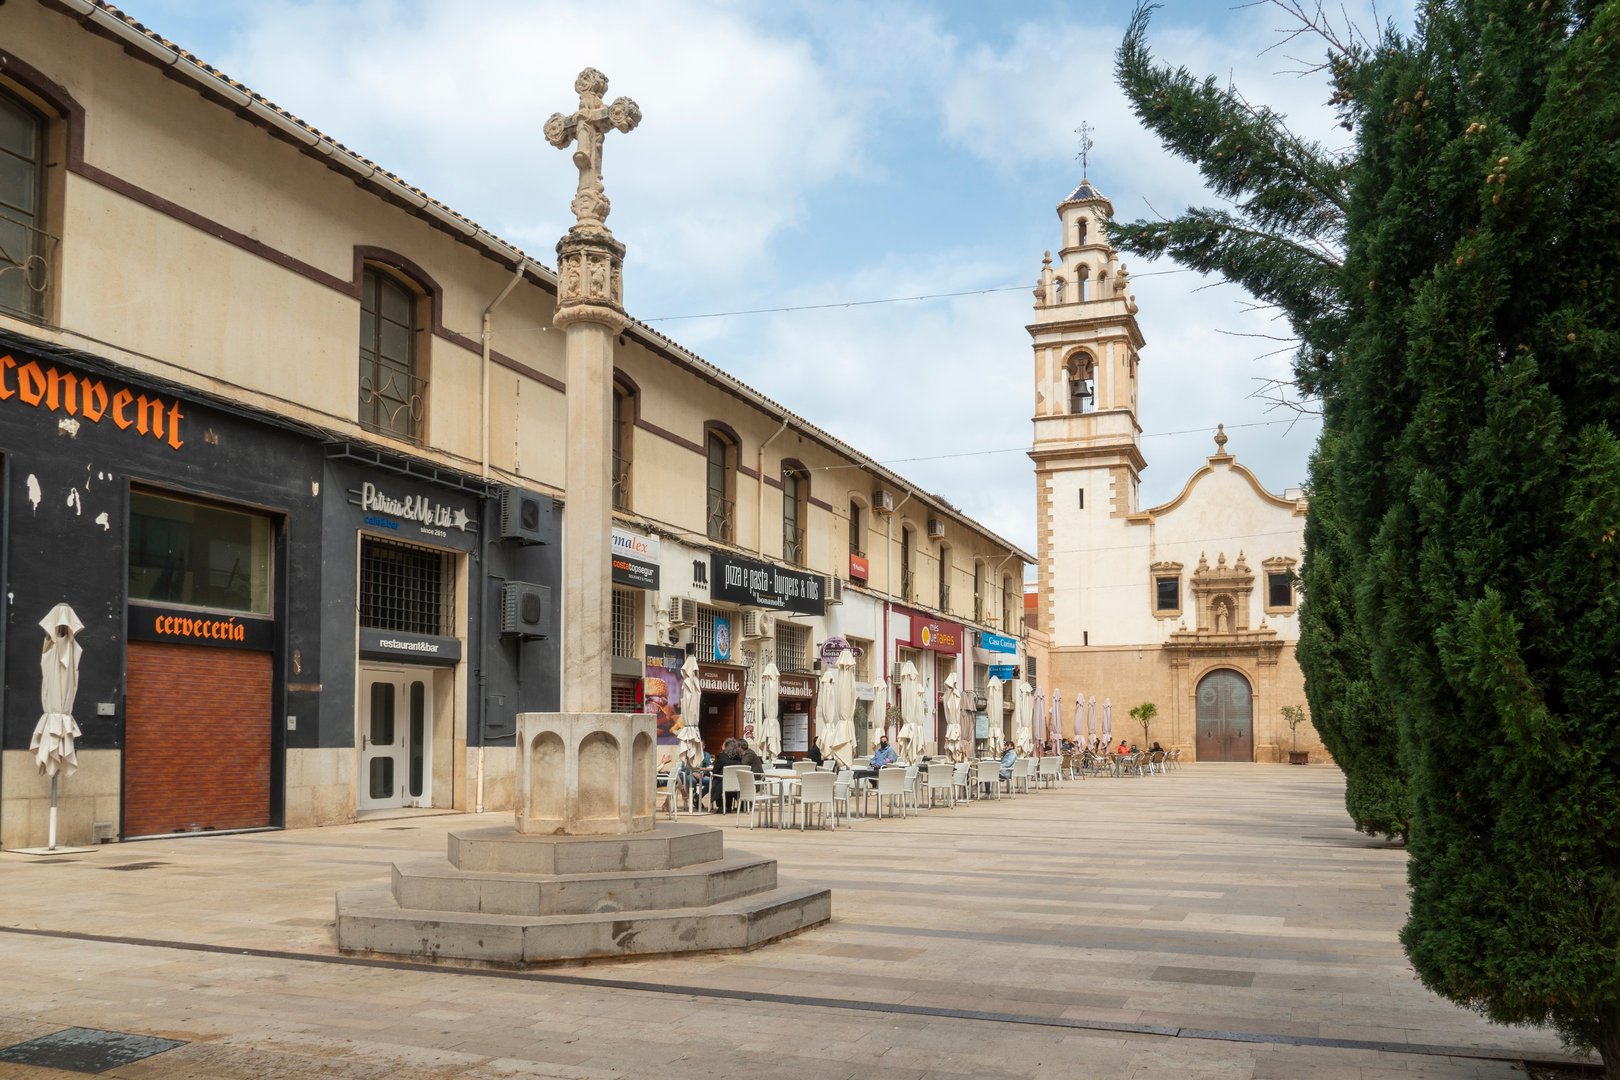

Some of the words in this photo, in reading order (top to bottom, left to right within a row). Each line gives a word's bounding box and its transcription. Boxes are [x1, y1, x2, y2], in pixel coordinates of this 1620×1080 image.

[0, 354, 184, 450] convent
[420, 526, 434, 535] since
[434, 529, 447, 538] 2019
[725, 560, 742, 590] pizza
[743, 568, 748, 588] e
[749, 568, 769, 594] pasta
[774, 568, 799, 601] burgers
[800, 579, 806, 598] &
[806, 576, 819, 601] ribs
[756, 592, 786, 608] bonanotte
[155, 613, 245, 642] cervecería
[379, 638, 439, 653] restaurant&bar
[988, 636, 999, 646] Casa
[700, 672, 740, 692] onanotte
